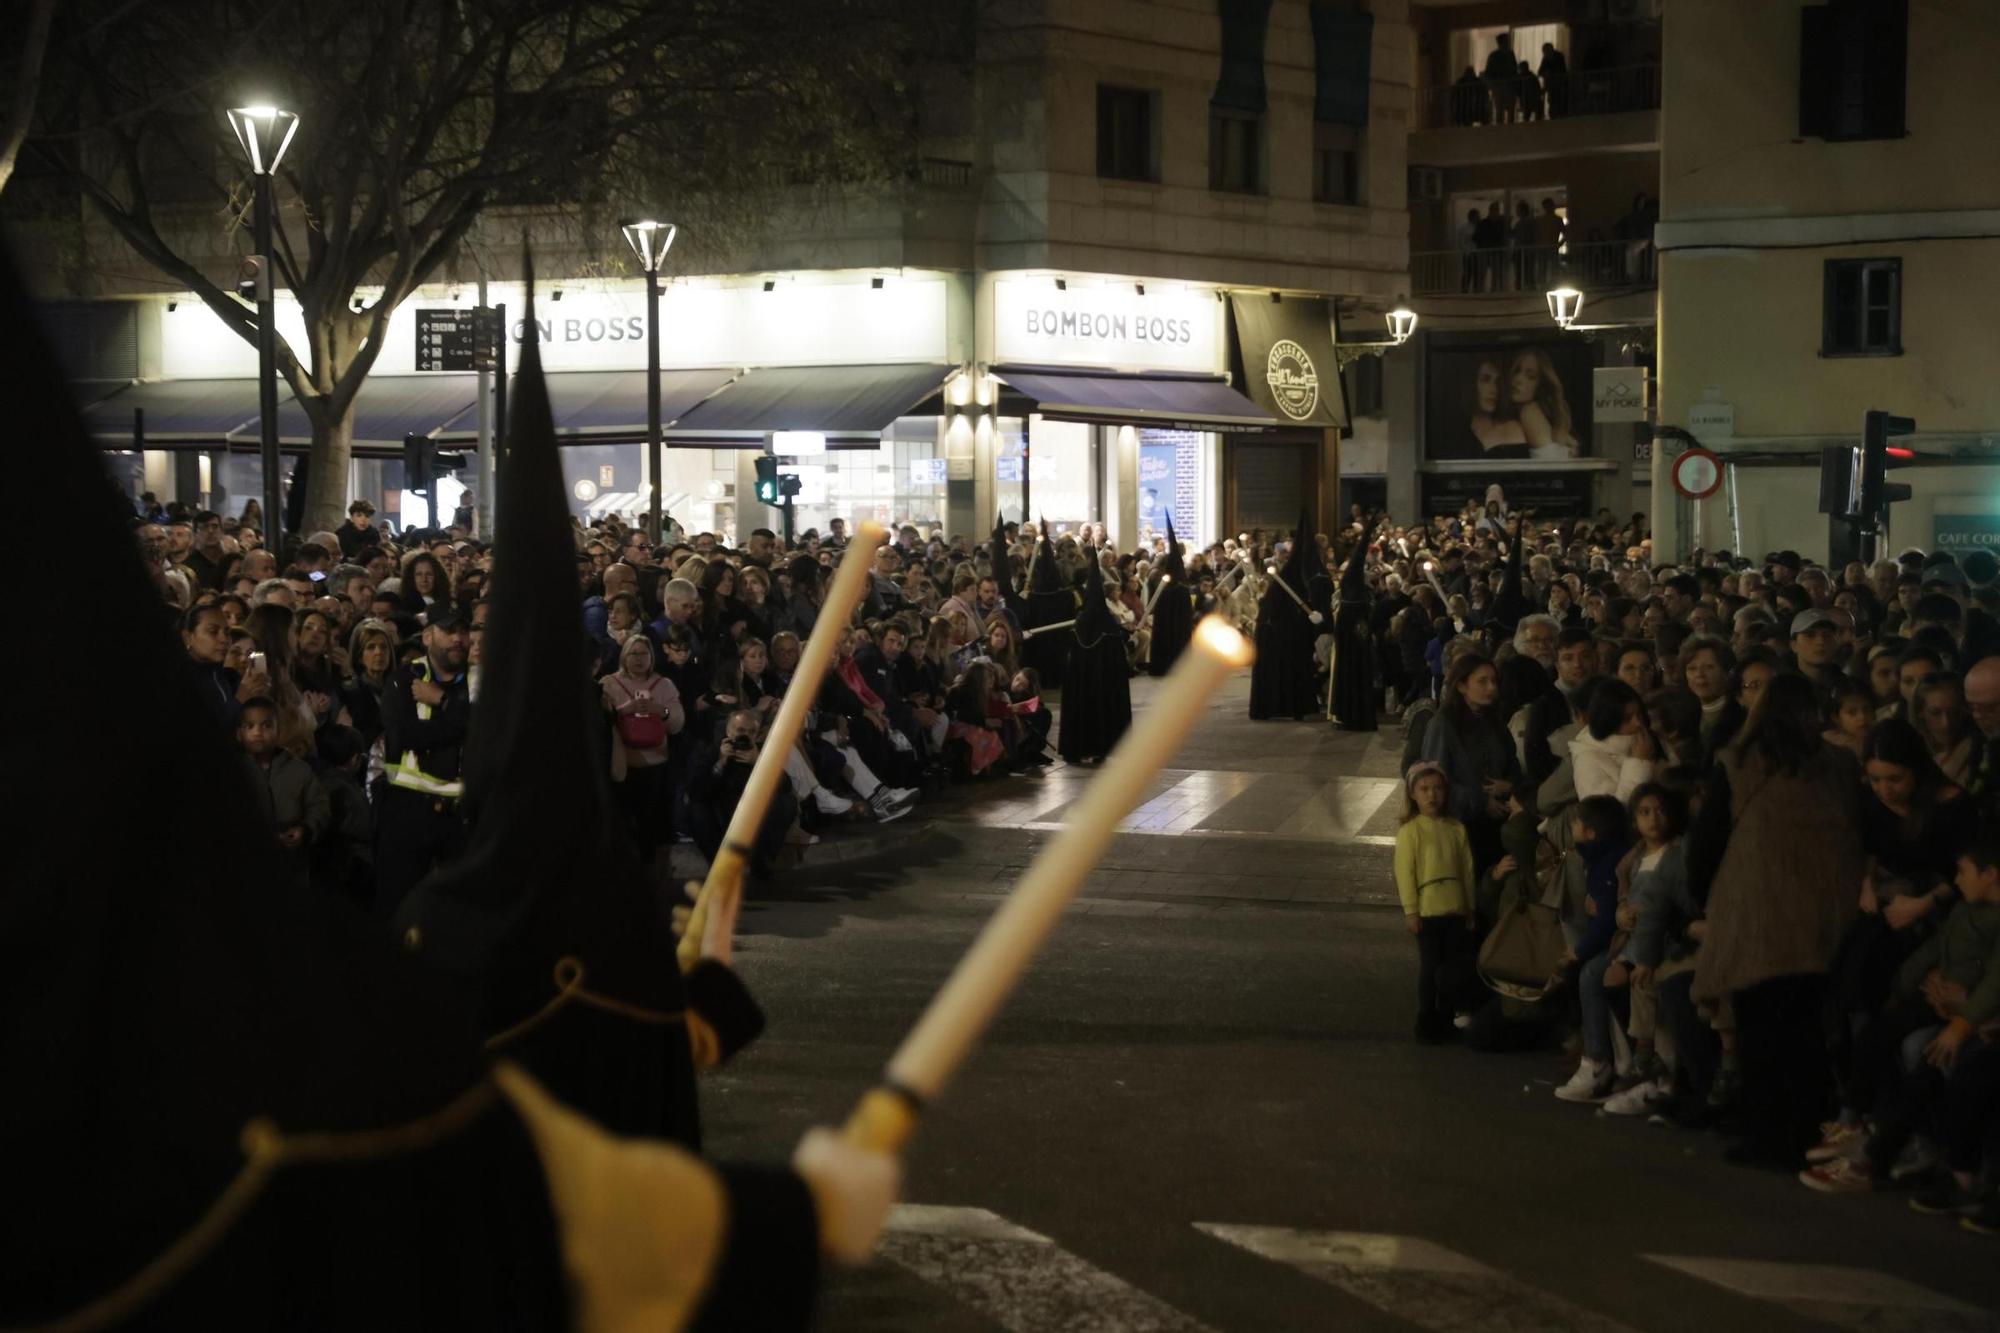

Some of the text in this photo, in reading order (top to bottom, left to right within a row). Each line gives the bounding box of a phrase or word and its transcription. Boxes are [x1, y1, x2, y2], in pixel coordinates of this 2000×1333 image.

[565, 316, 644, 342] BOSS
[1026, 309, 1191, 344] BOMBON BOSS
[1595, 399, 1611, 408] MY
